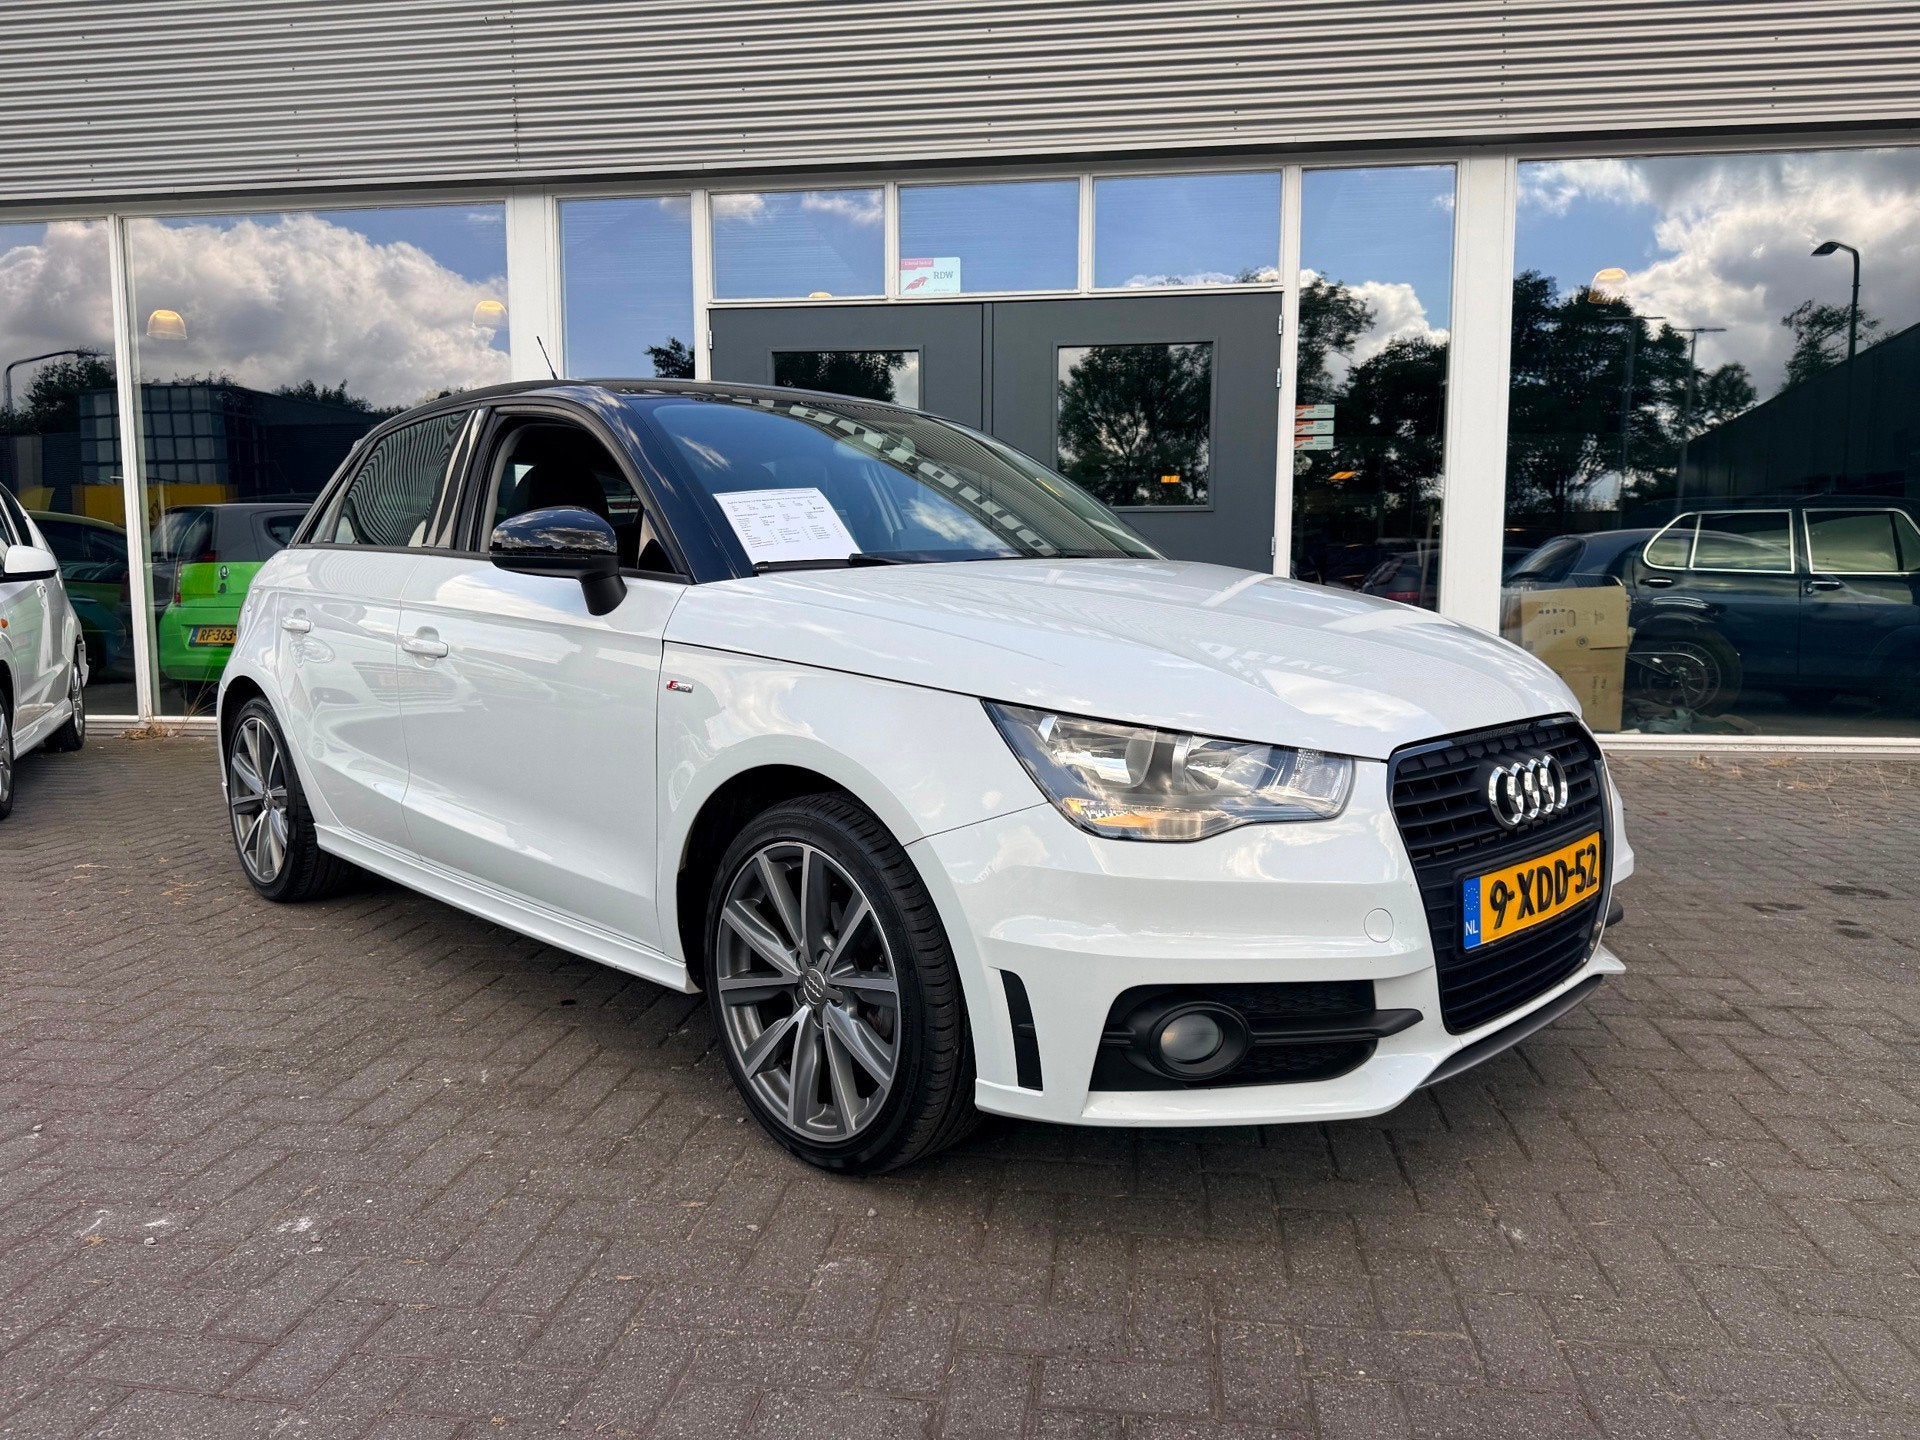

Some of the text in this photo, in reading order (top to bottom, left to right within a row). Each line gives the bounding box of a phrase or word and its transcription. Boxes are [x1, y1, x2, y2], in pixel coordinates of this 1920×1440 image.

[933, 270, 954, 280] RDW
[200, 629, 237, 641] RF-363-
[1489, 843, 1598, 930] 9-XDD-52
[1465, 920, 1479, 936] NL
